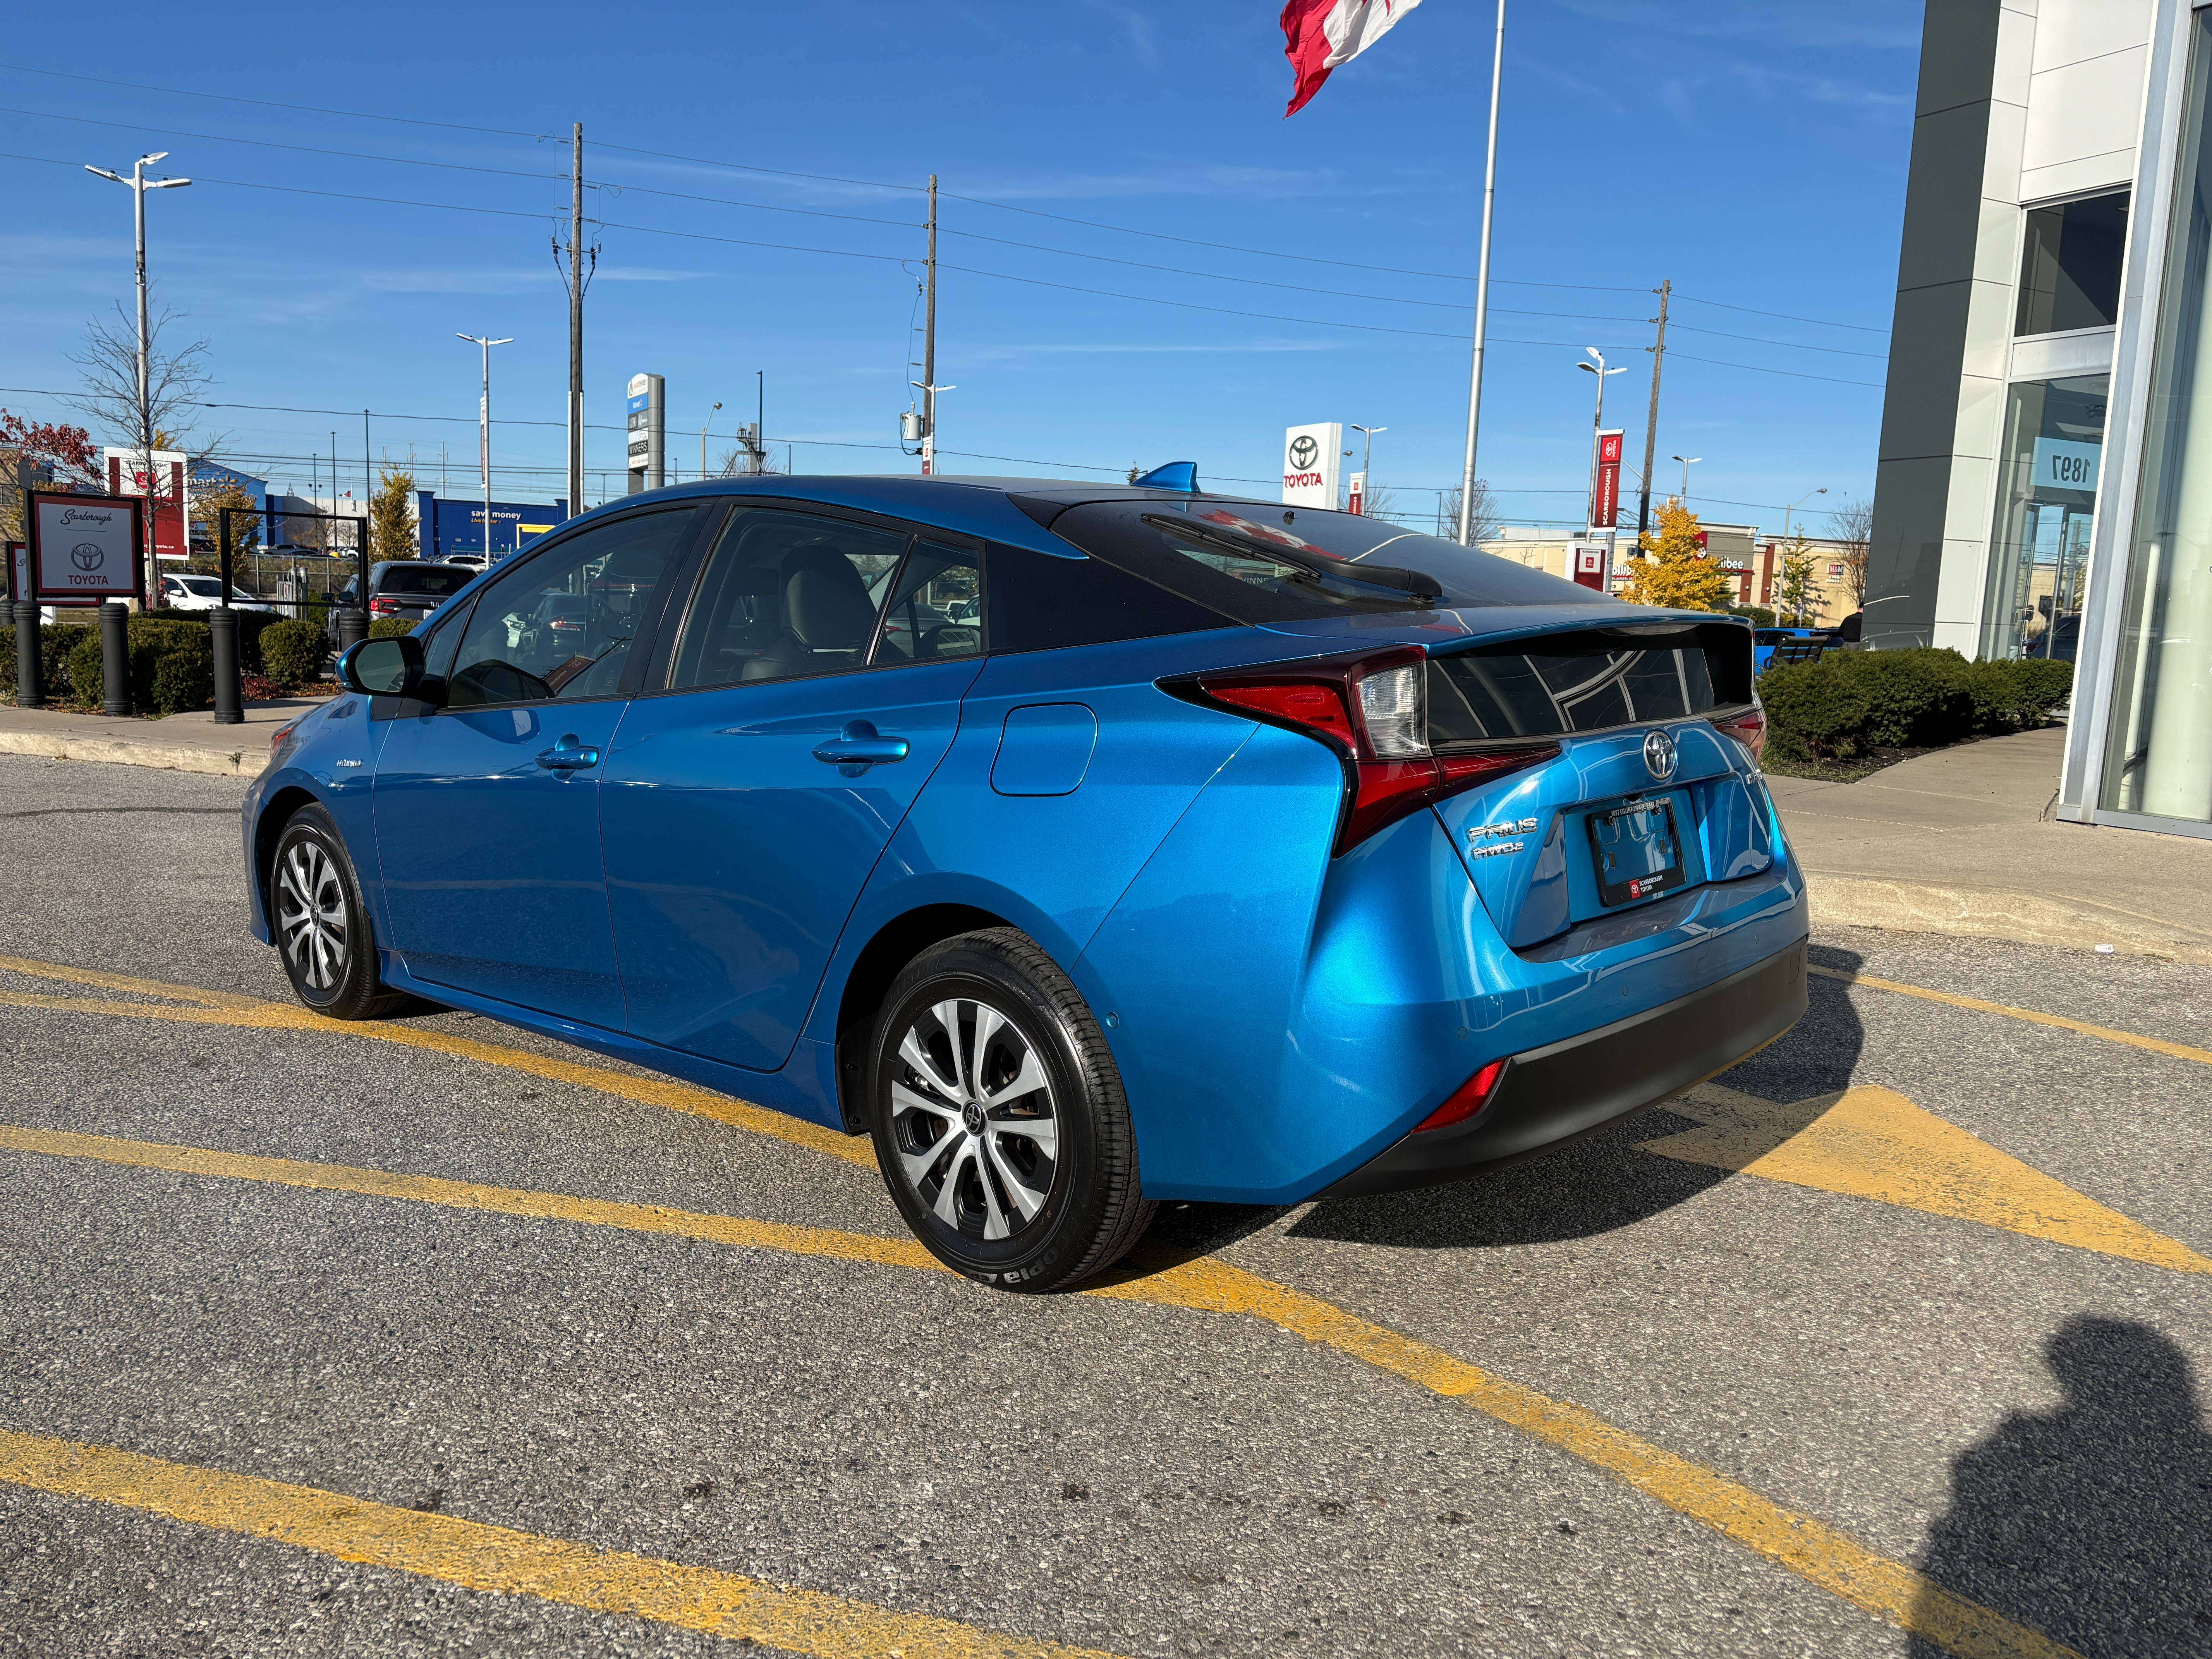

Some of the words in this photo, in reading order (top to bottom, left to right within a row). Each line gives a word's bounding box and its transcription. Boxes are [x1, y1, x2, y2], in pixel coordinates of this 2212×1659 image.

[1283, 472, 1324, 488] TOYOTA
[1602, 468, 1612, 526] SCARBOROUGH
[60, 509, 112, 525] Scarborough
[492, 512, 521, 520] money
[68, 575, 109, 585] TOYOTA
[1611, 809, 1620, 817] 1897
[1620, 805, 1638, 815] EGLINTON
[1465, 817, 1538, 842] PRIUS
[1639, 875, 1663, 886] SCARBOROUGH
[1640, 884, 1653, 893] TOYOTA
